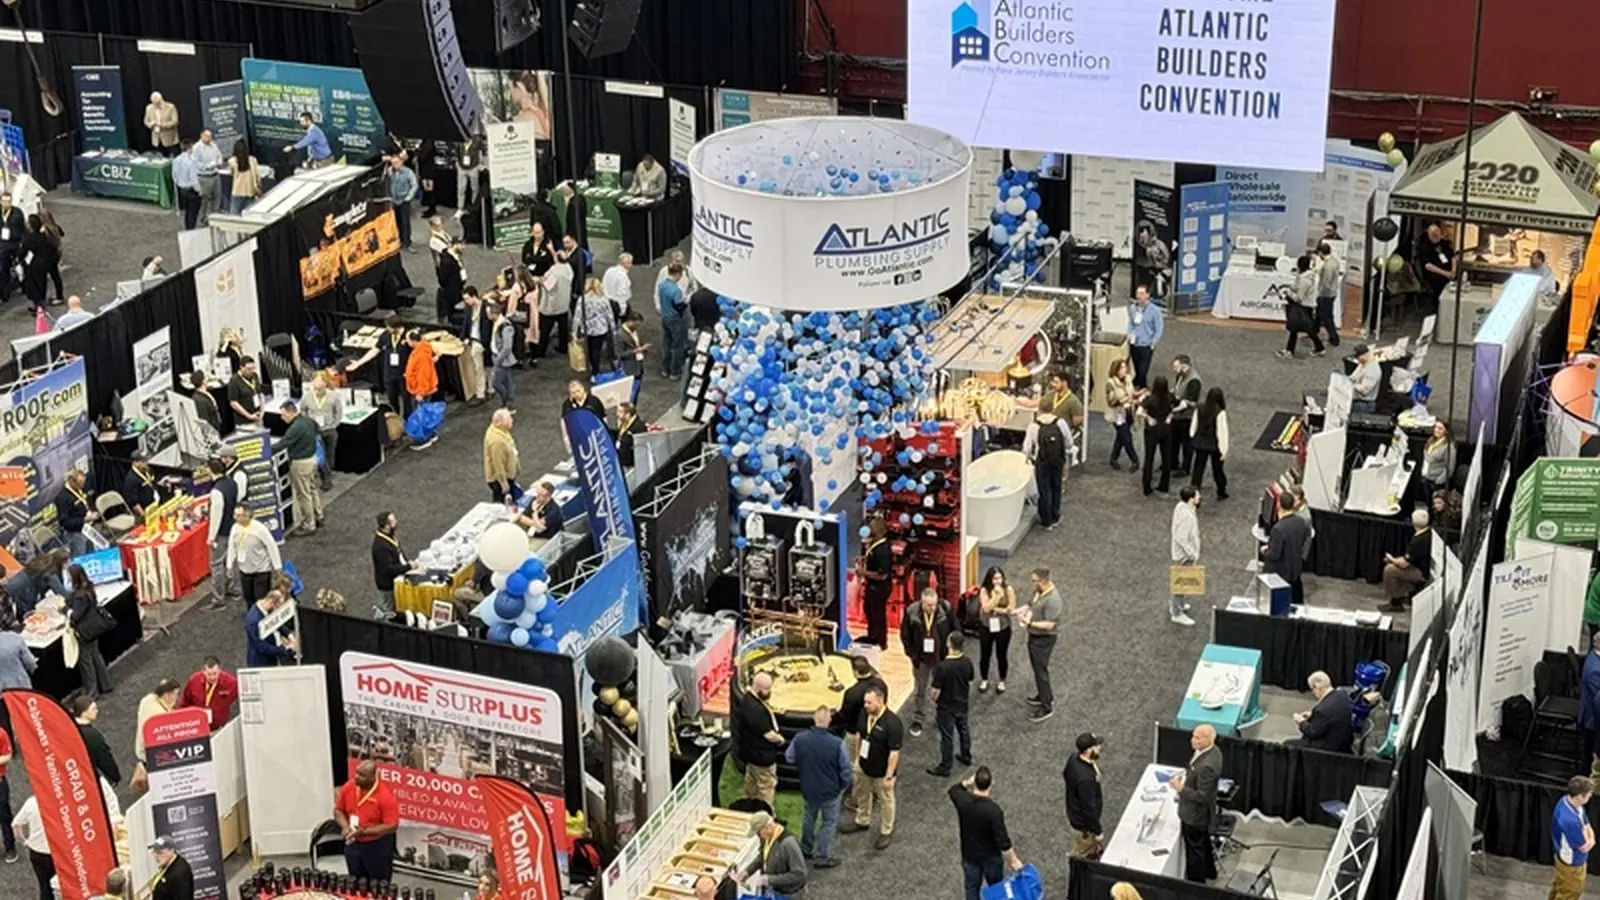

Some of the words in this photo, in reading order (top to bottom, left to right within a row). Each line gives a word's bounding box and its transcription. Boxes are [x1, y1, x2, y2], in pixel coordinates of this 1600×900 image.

[993, 0, 1073, 21] Atlantic
[995, 19, 1075, 45] Builders
[1158, 8, 1269, 41] ATLANTIC
[994, 41, 1111, 70] Convention
[1156, 47, 1268, 80] BUILDERS
[1139, 84, 1281, 119] CONVENTION
[101, 163, 133, 181] CBIZ
[1225, 171, 1259, 181] Direct
[1420, 204, 1502, 220] CONSTRCTION
[813, 207, 950, 255] ATLANTIC
[815, 250, 900, 269] PLUMBING
[904, 237, 951, 261] SUPPLY
[841, 256, 934, 278] www.GoAtlantic.com
[357, 673, 429, 704] HOME
[436, 690, 543, 725] SURPLUS
[152, 719, 201, 735] ATTENTION
[358, 694, 375, 705] THE
[383, 698, 424, 714] CABINET
[444, 711, 470, 722] DOOR
[478, 718, 542, 737] SUPERSTORE
[174, 744, 205, 760] VIP
[27, 697, 49, 748] Cabinets
[45, 751, 65, 800] Vanities
[59, 804, 75, 839] Doors
[64, 758, 87, 802] GRAB
[406, 774, 464, 796] 20,000
[77, 805, 89, 817] &
[400, 804, 457, 822] ERYDAY
[442, 799, 487, 814] AVAILA
[80, 818, 96, 843] GO
[508, 810, 534, 886] HOME
